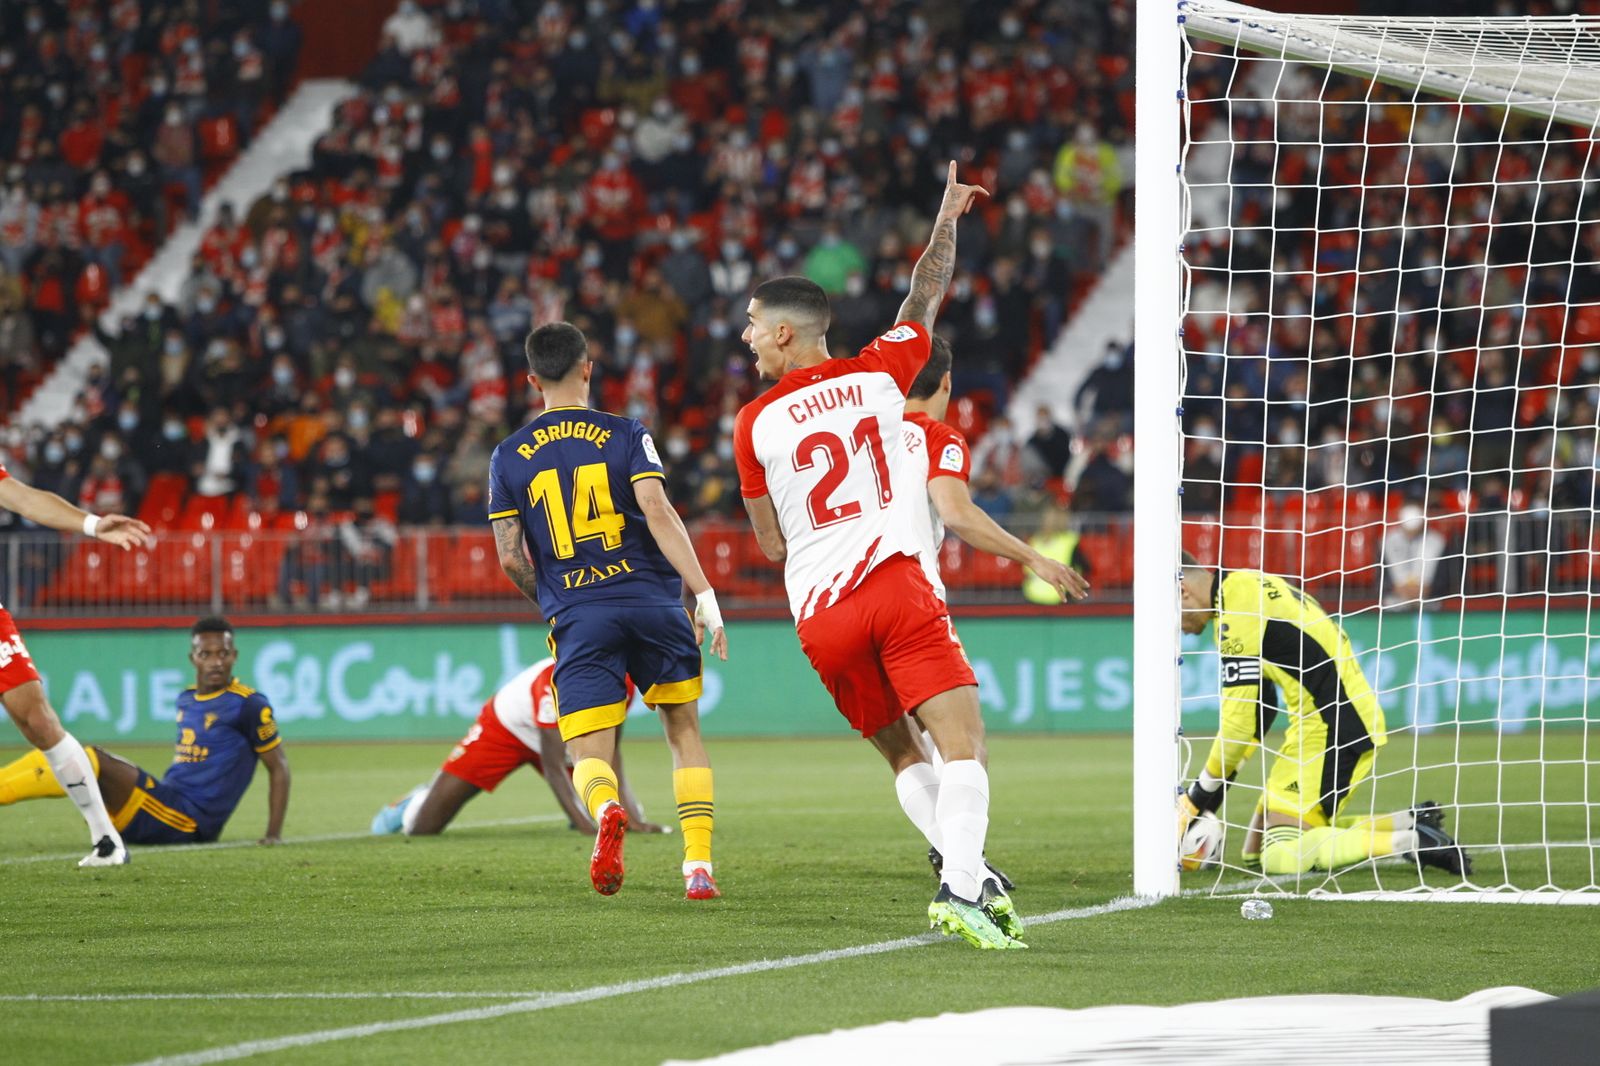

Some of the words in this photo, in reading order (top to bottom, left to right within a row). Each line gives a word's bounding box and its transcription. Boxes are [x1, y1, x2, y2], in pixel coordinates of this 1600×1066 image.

[787, 385, 864, 425] CHUMI
[516, 420, 612, 460] R.BRUGUÉ
[791, 415, 893, 531] 21
[527, 462, 626, 560] 14
[561, 558, 635, 590] IZADI
[41, 668, 185, 734] AJE
[253, 640, 325, 723] El
[327, 641, 487, 722] Corte
[973, 657, 1131, 724] AJES
